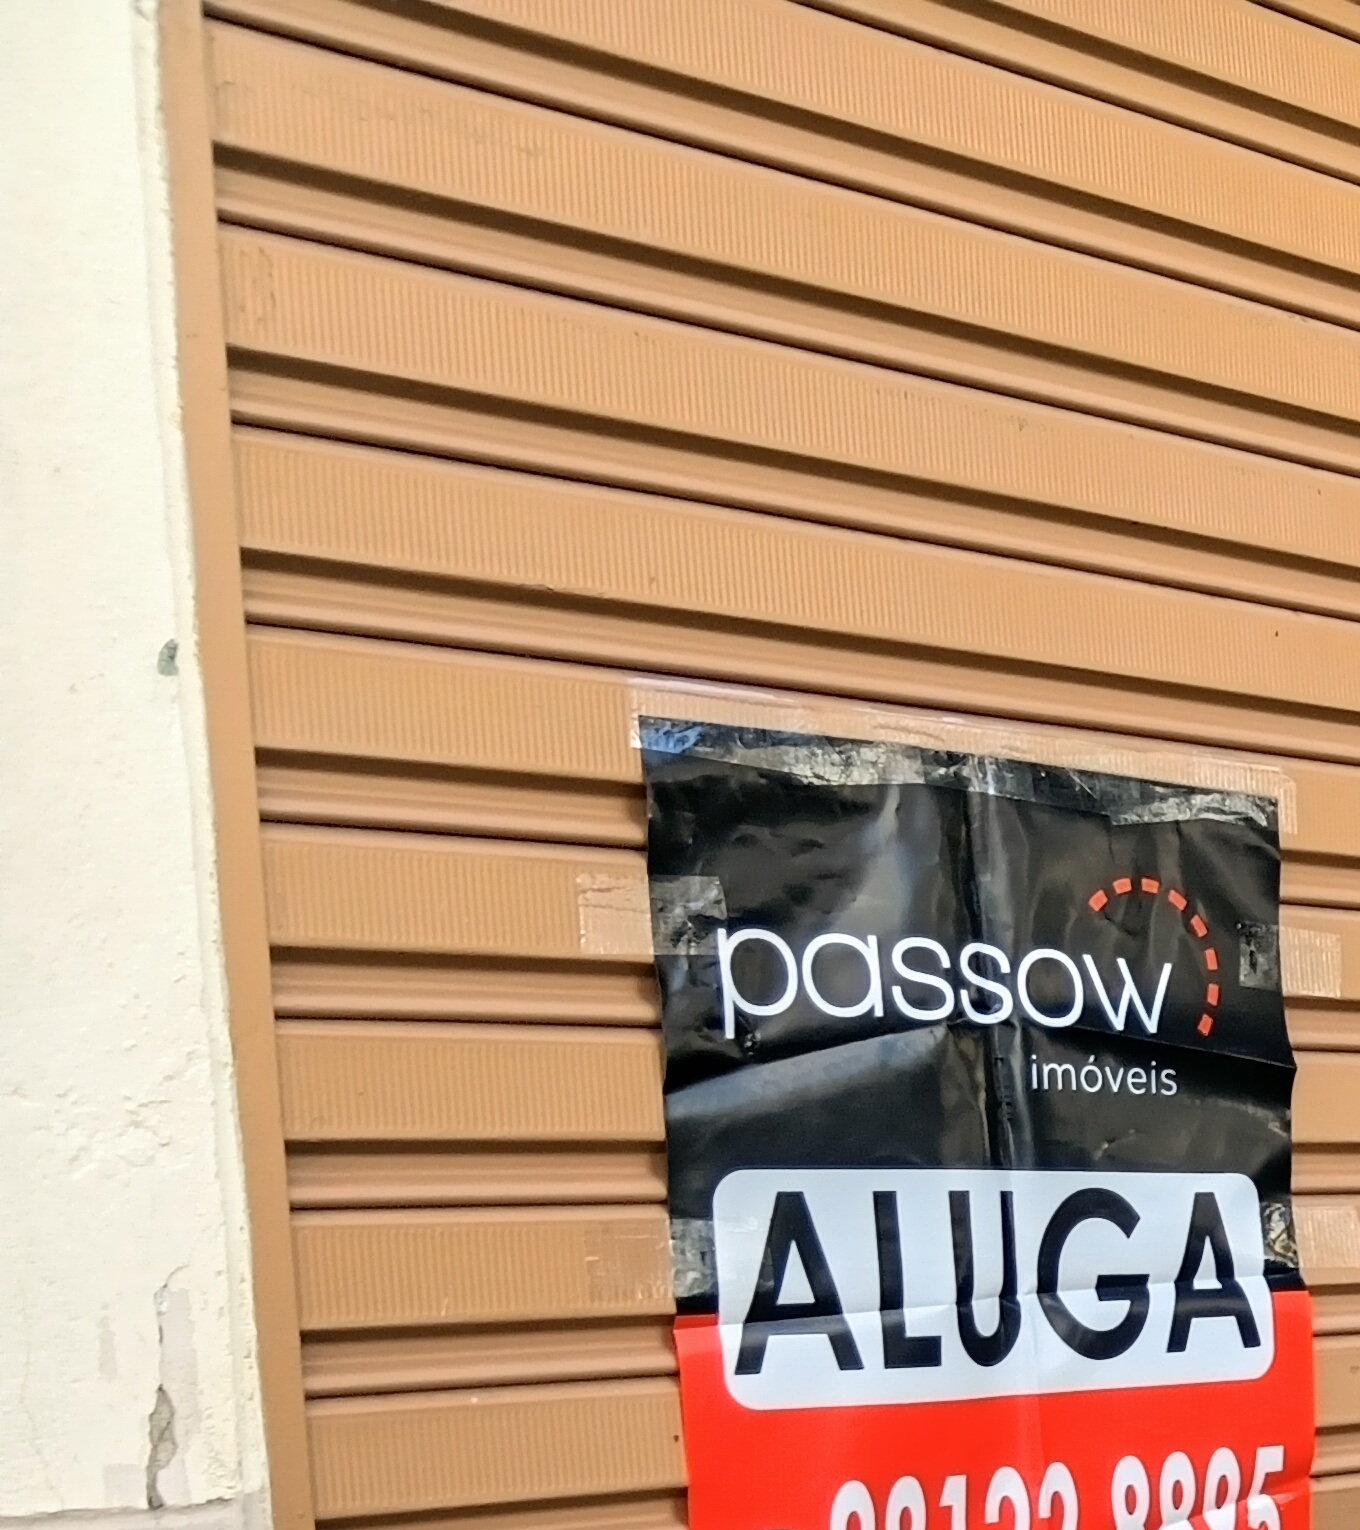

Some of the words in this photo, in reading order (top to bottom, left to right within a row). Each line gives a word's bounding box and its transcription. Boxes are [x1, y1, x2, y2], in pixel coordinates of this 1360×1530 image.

[716, 924, 1173, 1041] passow
[1030, 1053, 1179, 1099] imóveis
[734, 1187, 1262, 1377] ALUGA
